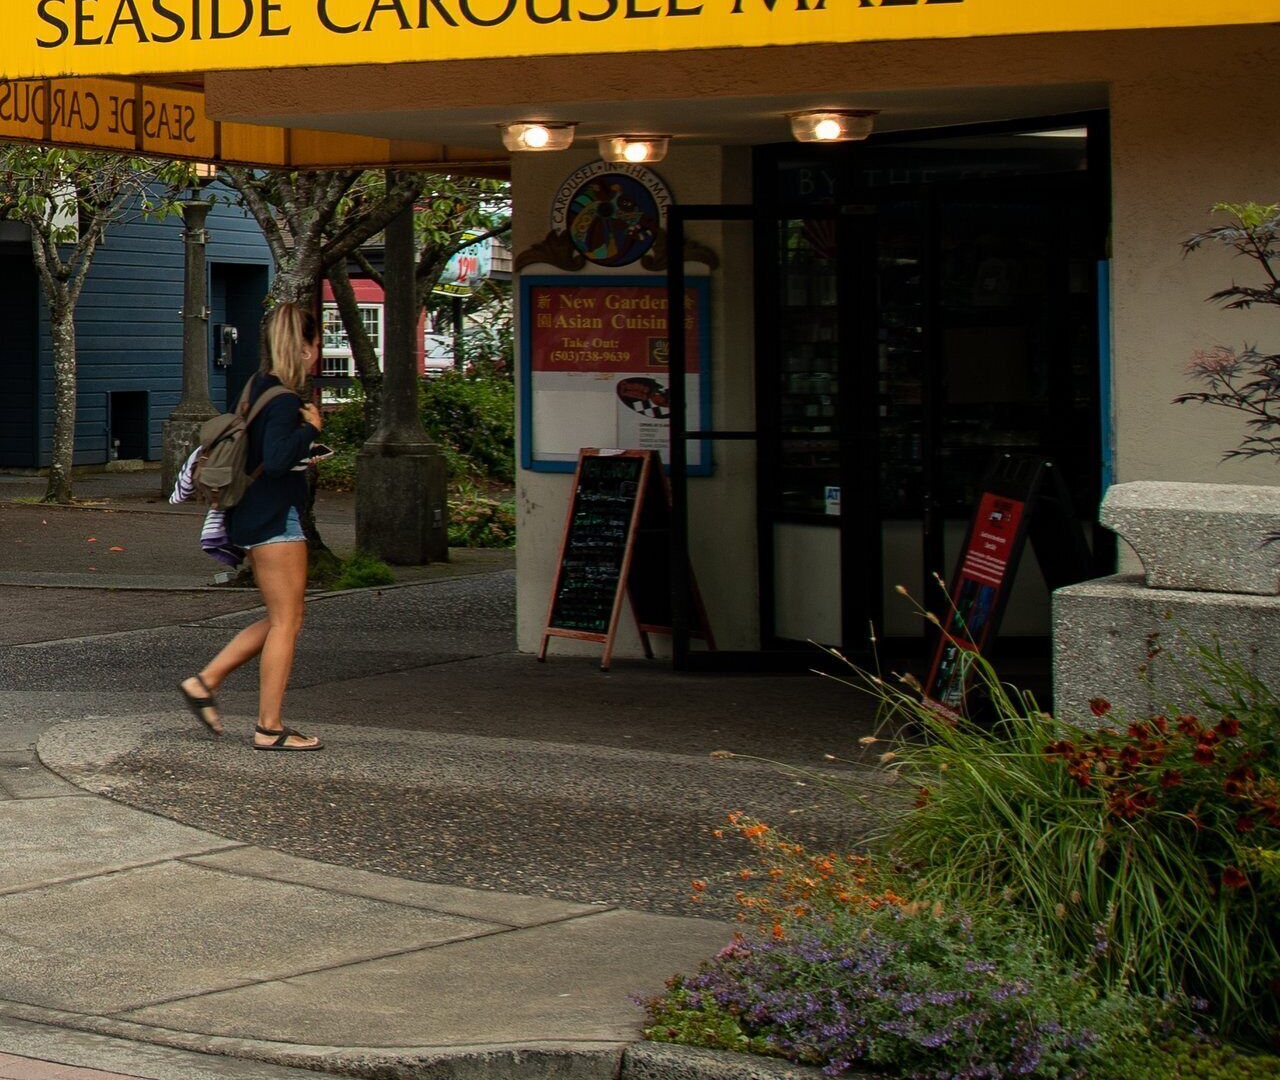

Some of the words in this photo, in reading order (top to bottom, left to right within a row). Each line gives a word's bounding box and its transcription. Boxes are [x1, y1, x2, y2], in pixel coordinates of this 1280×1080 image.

[799, 169, 838, 195] BY
[554, 166, 596, 225] CAROUSEL
[560, 294, 597, 310] New
[605, 294, 669, 310] Garden
[555, 315, 603, 329] Asian
[611, 314, 669, 330] Cuisin
[562, 338, 589, 348] Take
[592, 338, 619, 348] Out:
[550, 351, 630, 364] (503)738-9639
